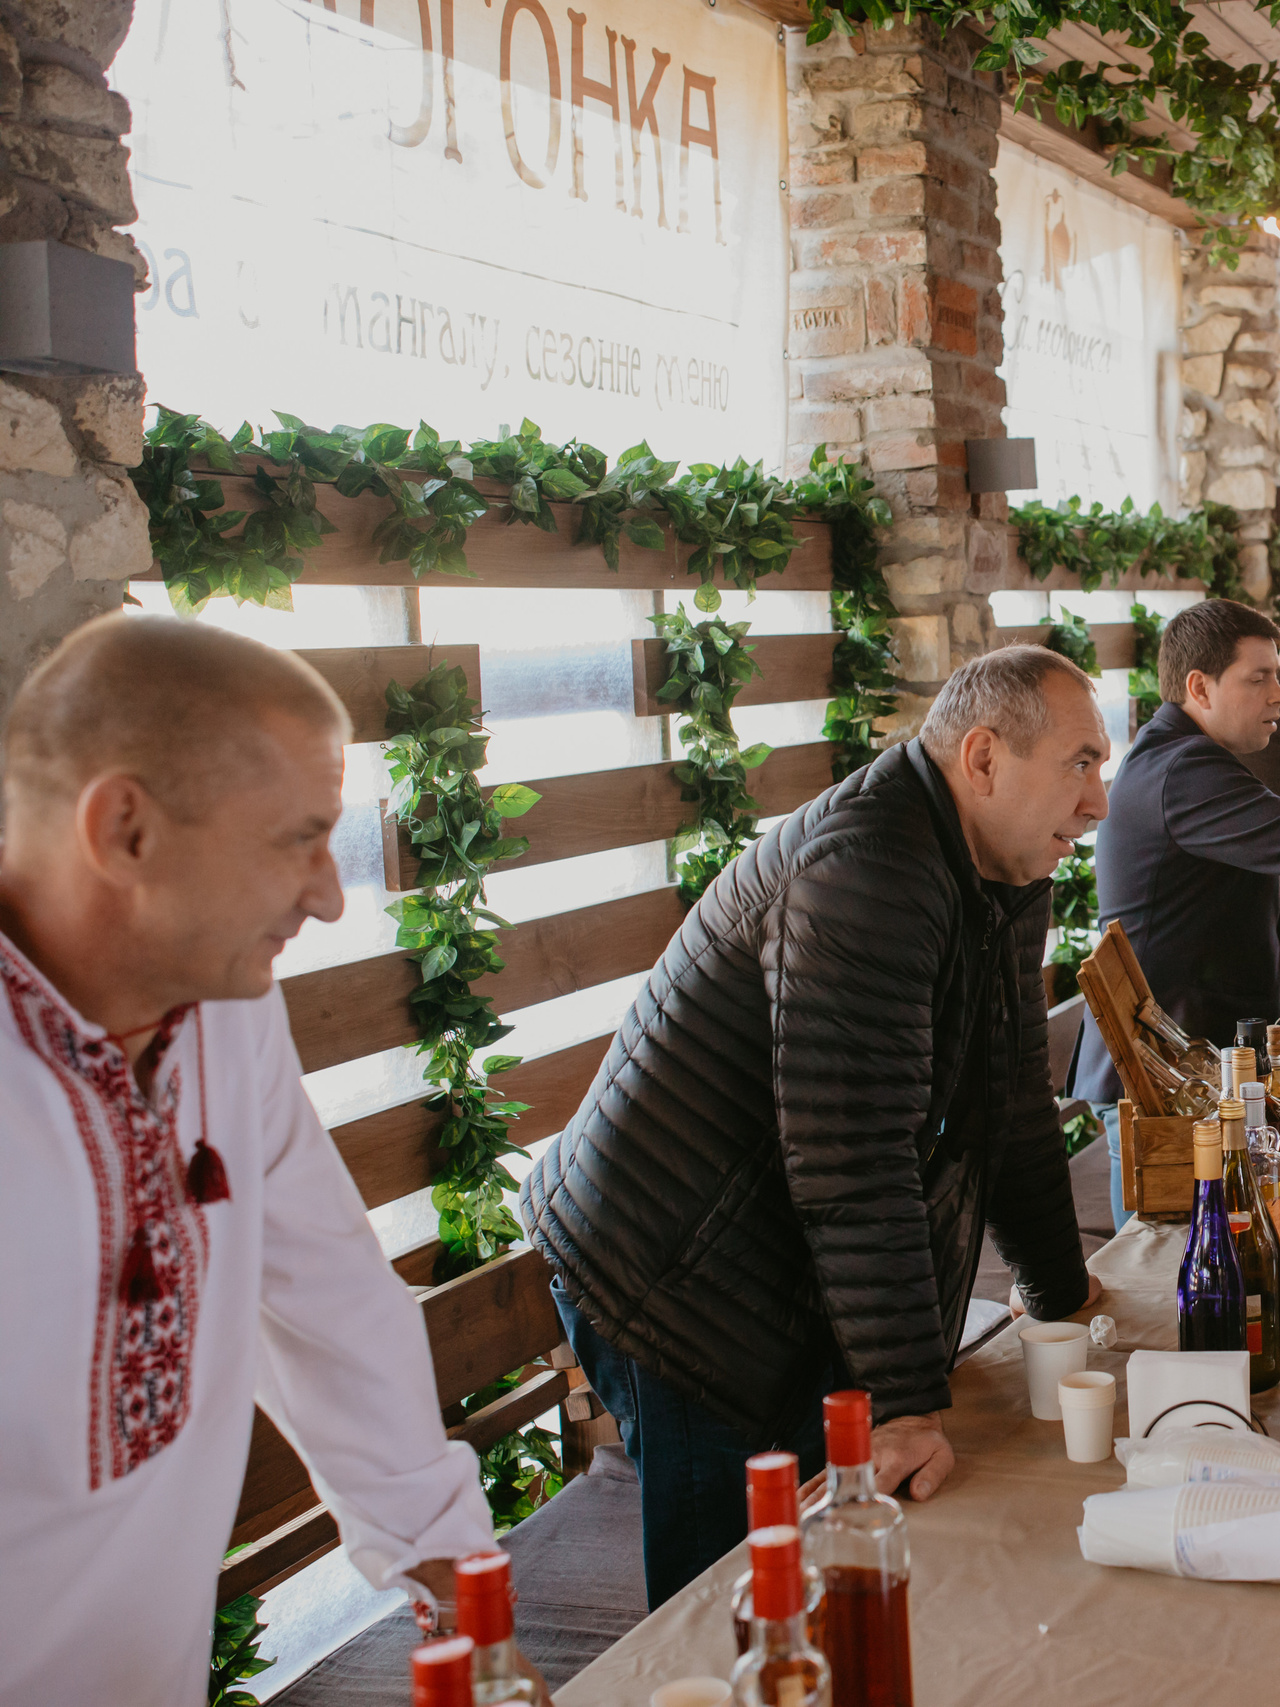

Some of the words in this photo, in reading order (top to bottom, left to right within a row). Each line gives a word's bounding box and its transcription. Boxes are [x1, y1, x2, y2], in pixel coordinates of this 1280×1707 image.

[300, 0, 727, 246] ОГОНКА
[524, 325, 641, 398] сезонне
[655, 350, 729, 412] меню
